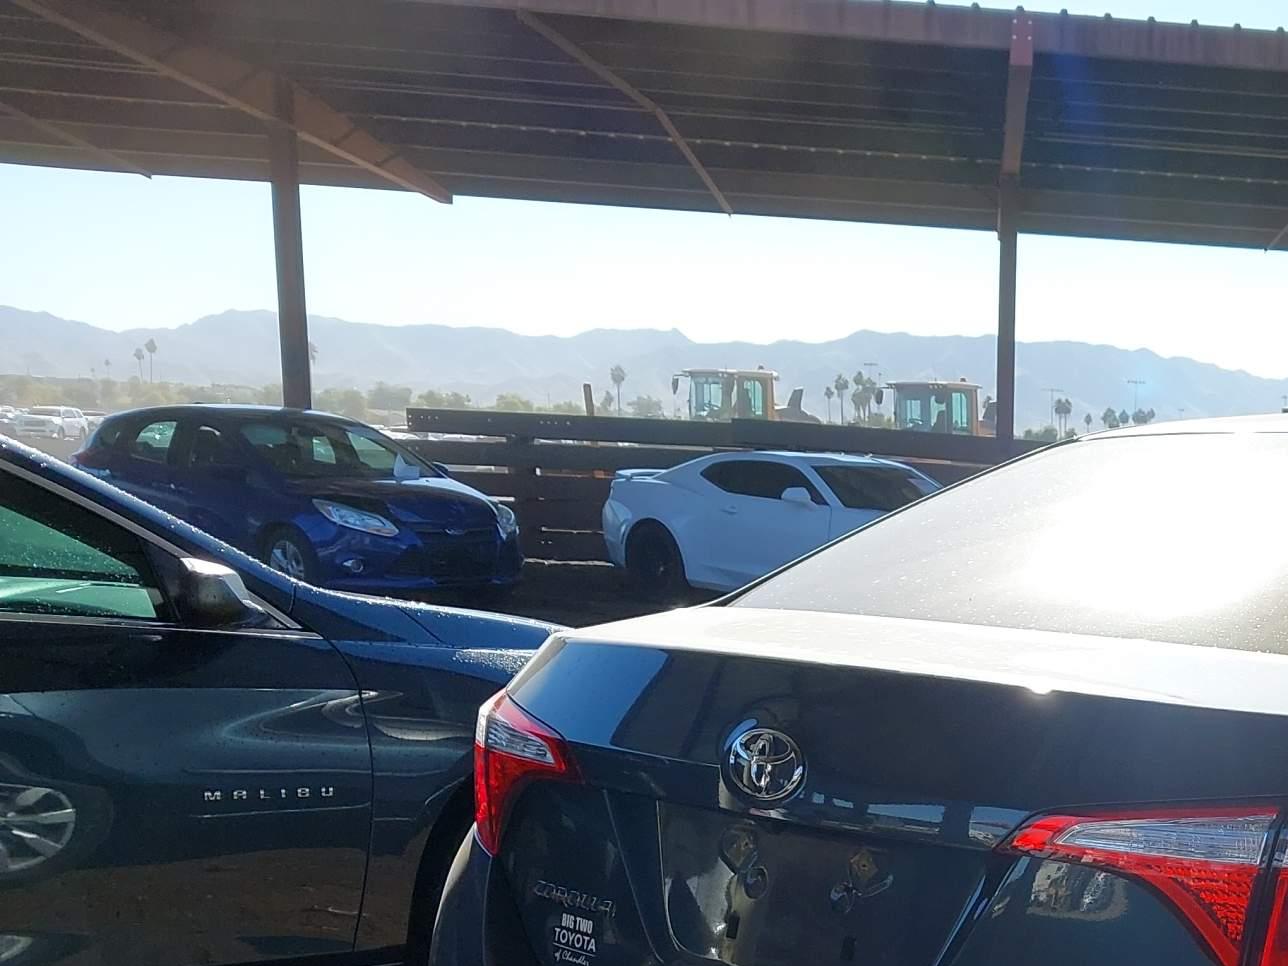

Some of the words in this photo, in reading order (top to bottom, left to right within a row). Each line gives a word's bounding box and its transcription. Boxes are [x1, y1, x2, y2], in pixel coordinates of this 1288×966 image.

[203, 786, 334, 801] MALIBU
[534, 880, 616, 918] COROLLA
[562, 913, 575, 929] BIG
[576, 917, 593, 934] TWO
[554, 928, 596, 952] TOYOTA
